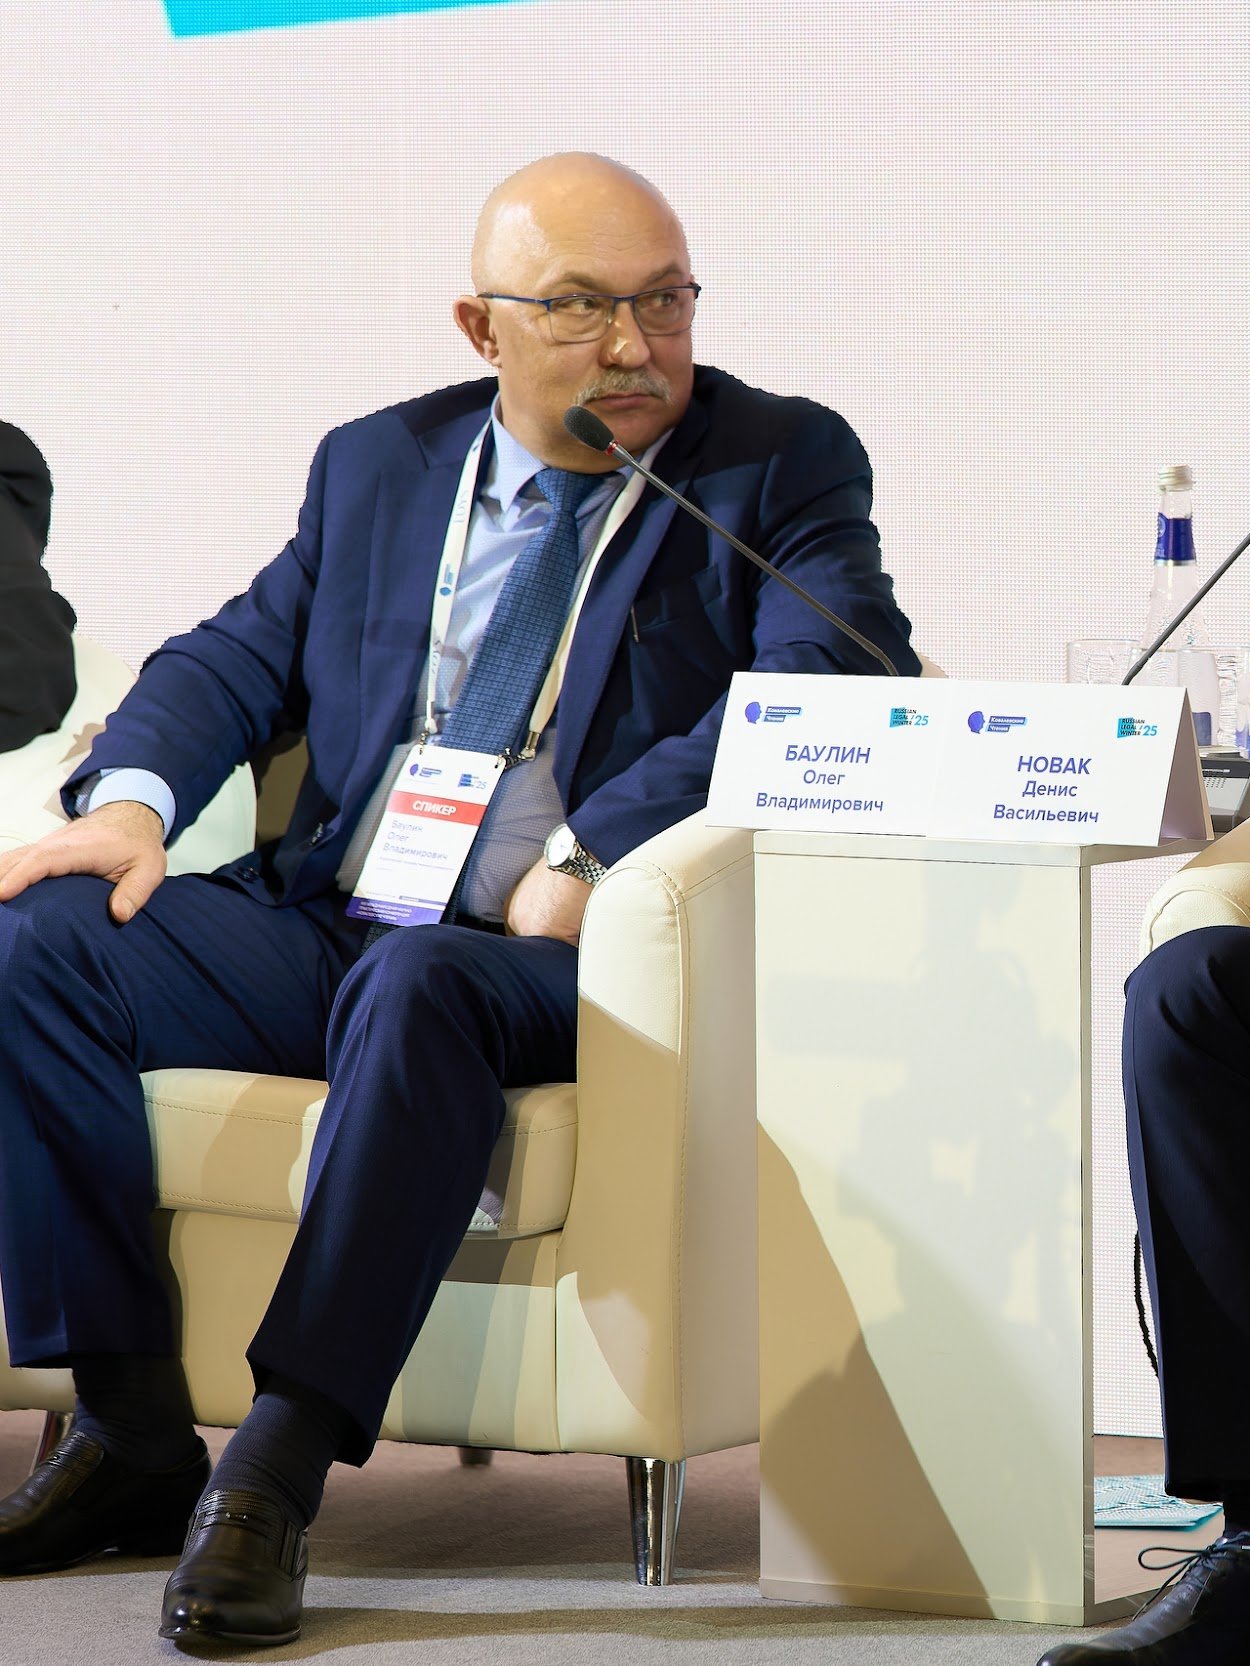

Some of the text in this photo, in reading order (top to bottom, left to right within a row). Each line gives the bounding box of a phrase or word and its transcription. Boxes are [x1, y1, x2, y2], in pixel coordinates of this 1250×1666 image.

[785, 745, 871, 764] БАУЛИН
[1017, 755, 1092, 775] НОВАК
[803, 769, 846, 785] Олег
[1022, 780, 1078, 798] Денис
[412, 800, 457, 816] СПИКЕР
[756, 792, 884, 814] Владимирович
[993, 804, 1099, 823] Васильевич
